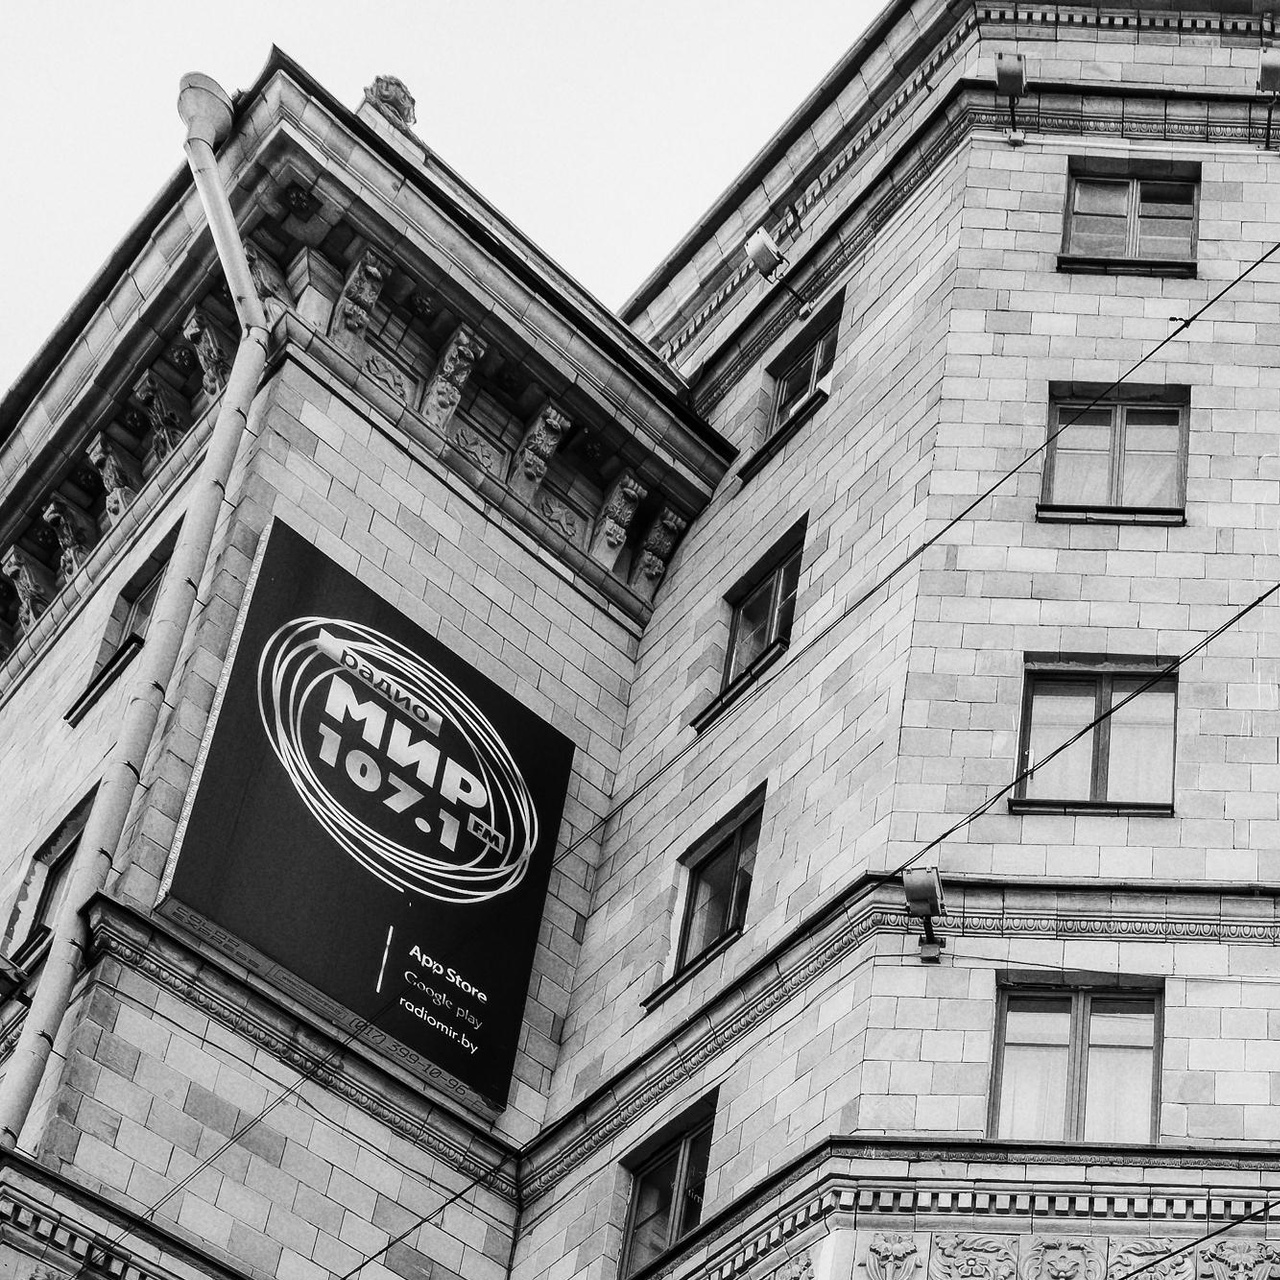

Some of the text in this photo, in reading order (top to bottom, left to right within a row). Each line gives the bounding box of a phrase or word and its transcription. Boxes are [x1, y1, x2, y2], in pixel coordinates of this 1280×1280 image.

[341, 651, 430, 723] радио
[324, 674, 488, 809] МИР
[472, 819, 501, 847] FM
[404, 971, 482, 1030] Google play
[409, 945, 487, 1004] App Store
[399, 997, 478, 1054] radiomir.by
